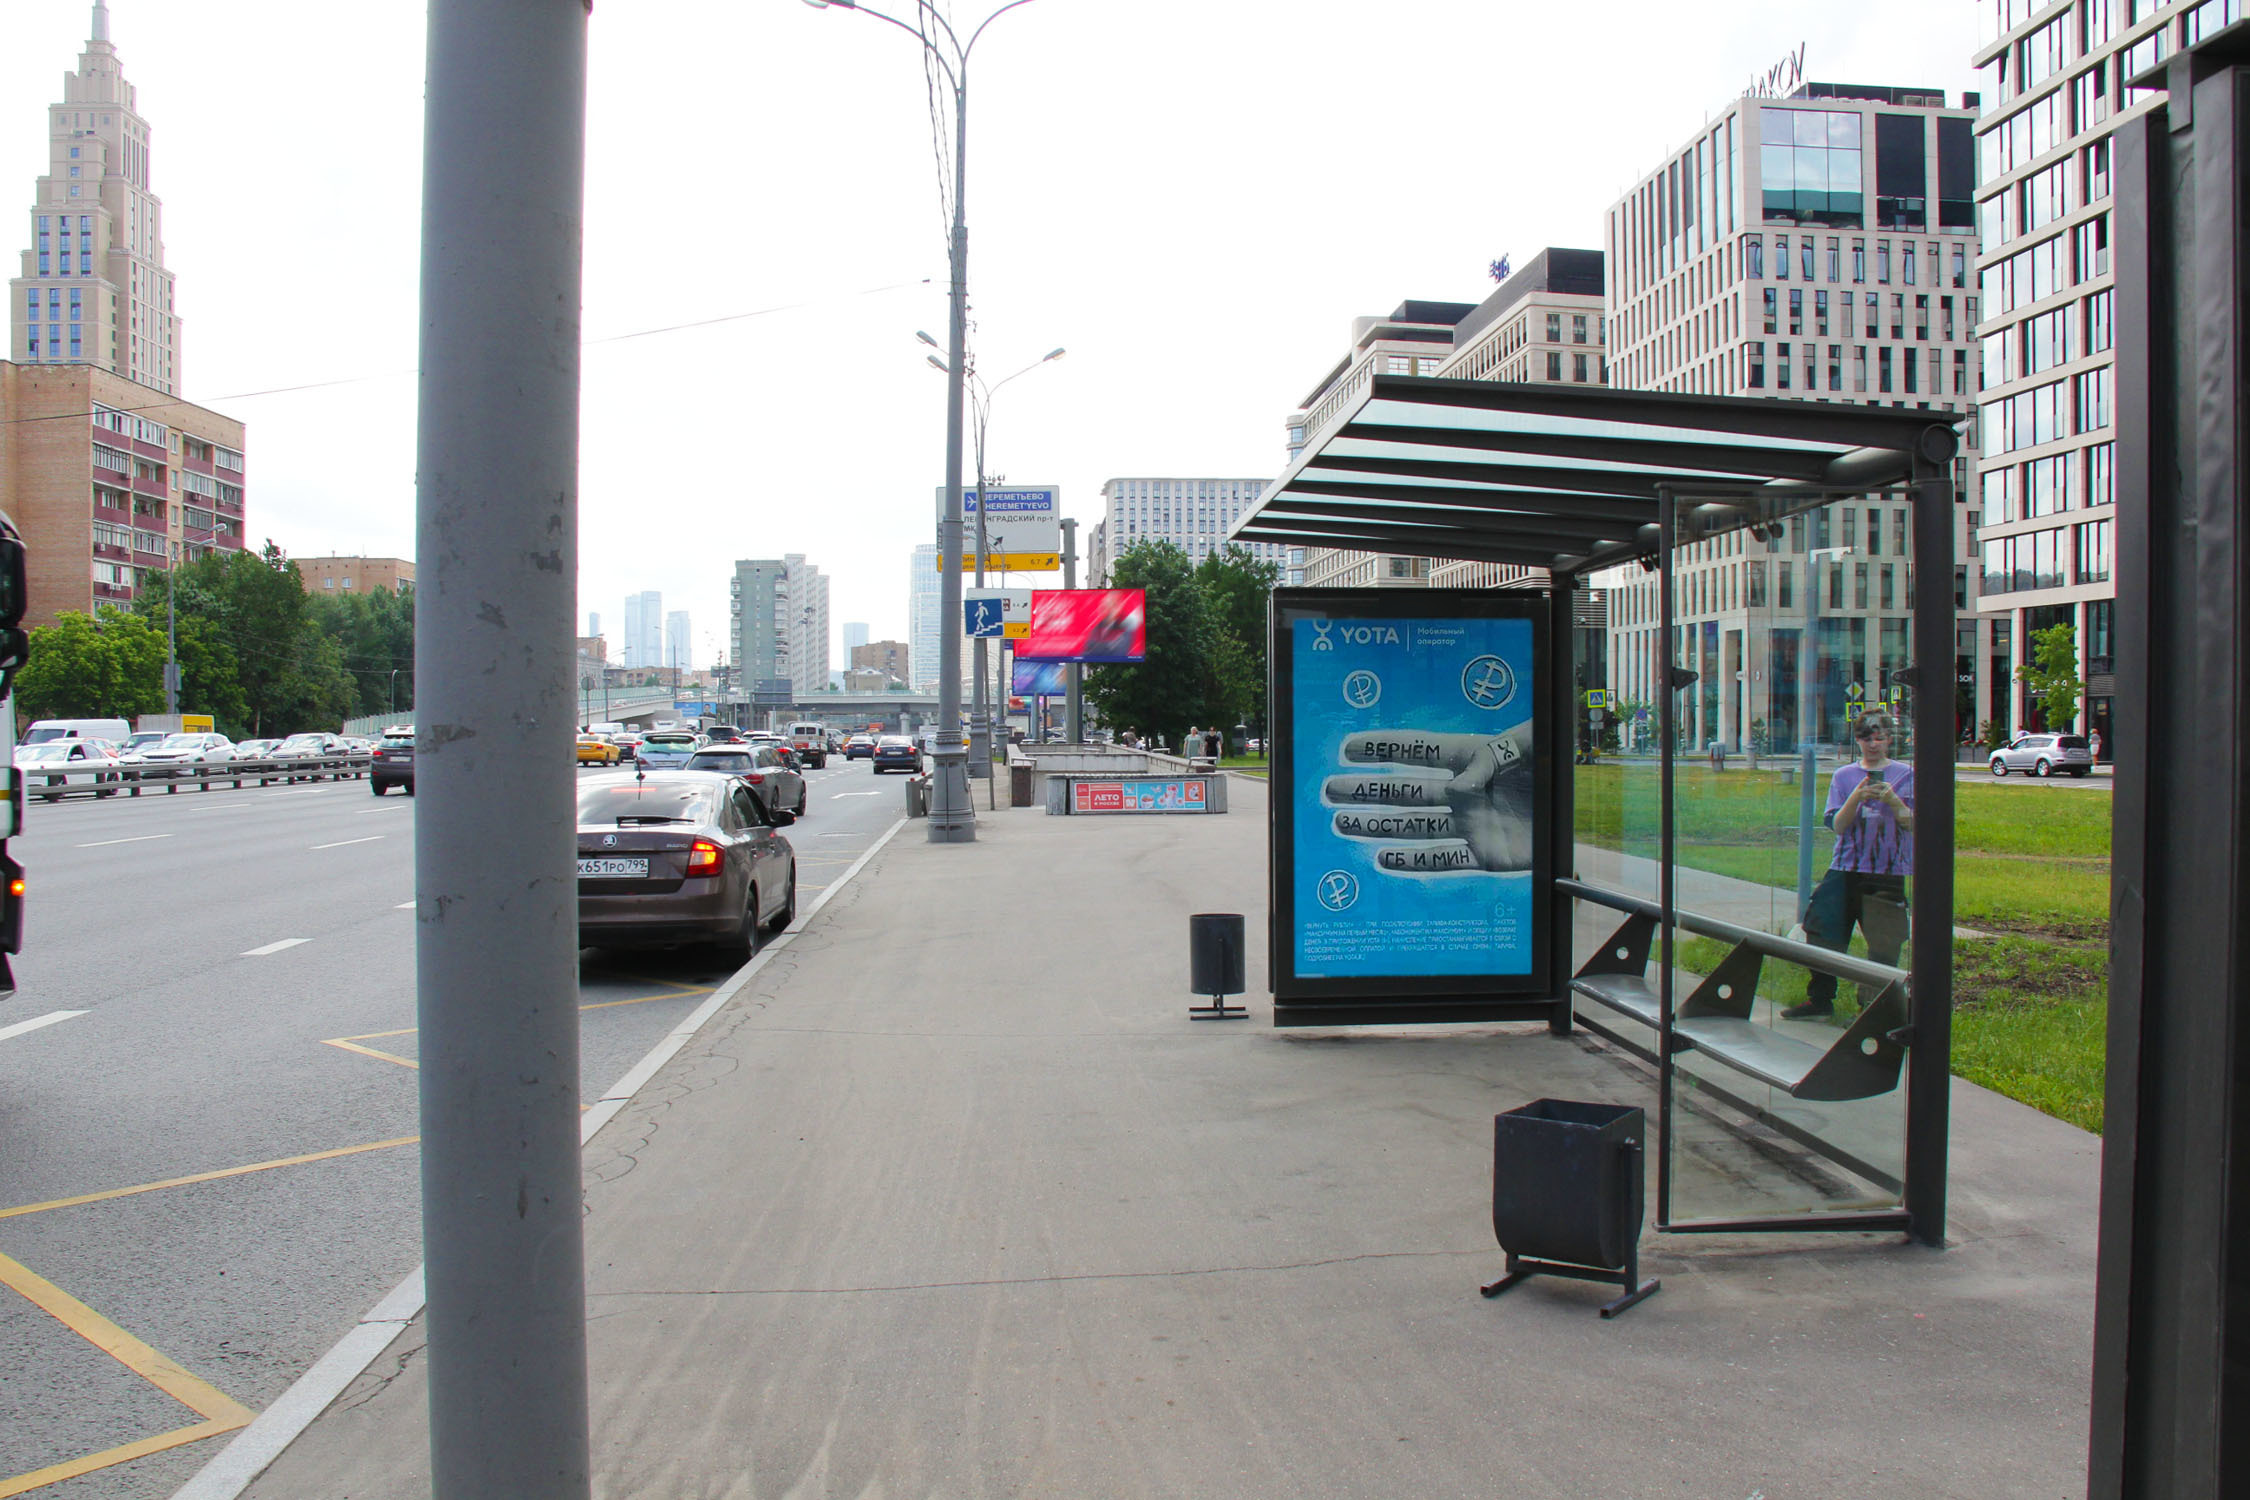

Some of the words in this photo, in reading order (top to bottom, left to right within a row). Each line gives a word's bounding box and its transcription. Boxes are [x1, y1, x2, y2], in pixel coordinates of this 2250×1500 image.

[984, 501, 1050, 511] HEREMET'YEVO
[963, 514, 1036, 524] ЛЕНГРАДСКИЙ
[1340, 626, 1400, 645] YOTA
[1416, 626, 1466, 636] Мобильный
[1416, 637, 1457, 647] оператор
[1364, 739, 1440, 761] ВЕРНЁМ
[1351, 782, 1423, 801] ДЕНЬГИ
[1340, 815, 1362, 831] ЗА
[1367, 816, 1450, 833] ОСТАТКИ
[627, 859, 645, 870] 799
[1384, 852, 1406, 867] ГБ
[1413, 852, 1426, 867] И
[1432, 849, 1470, 868] МИН
[1494, 902, 1517, 918] 6+
